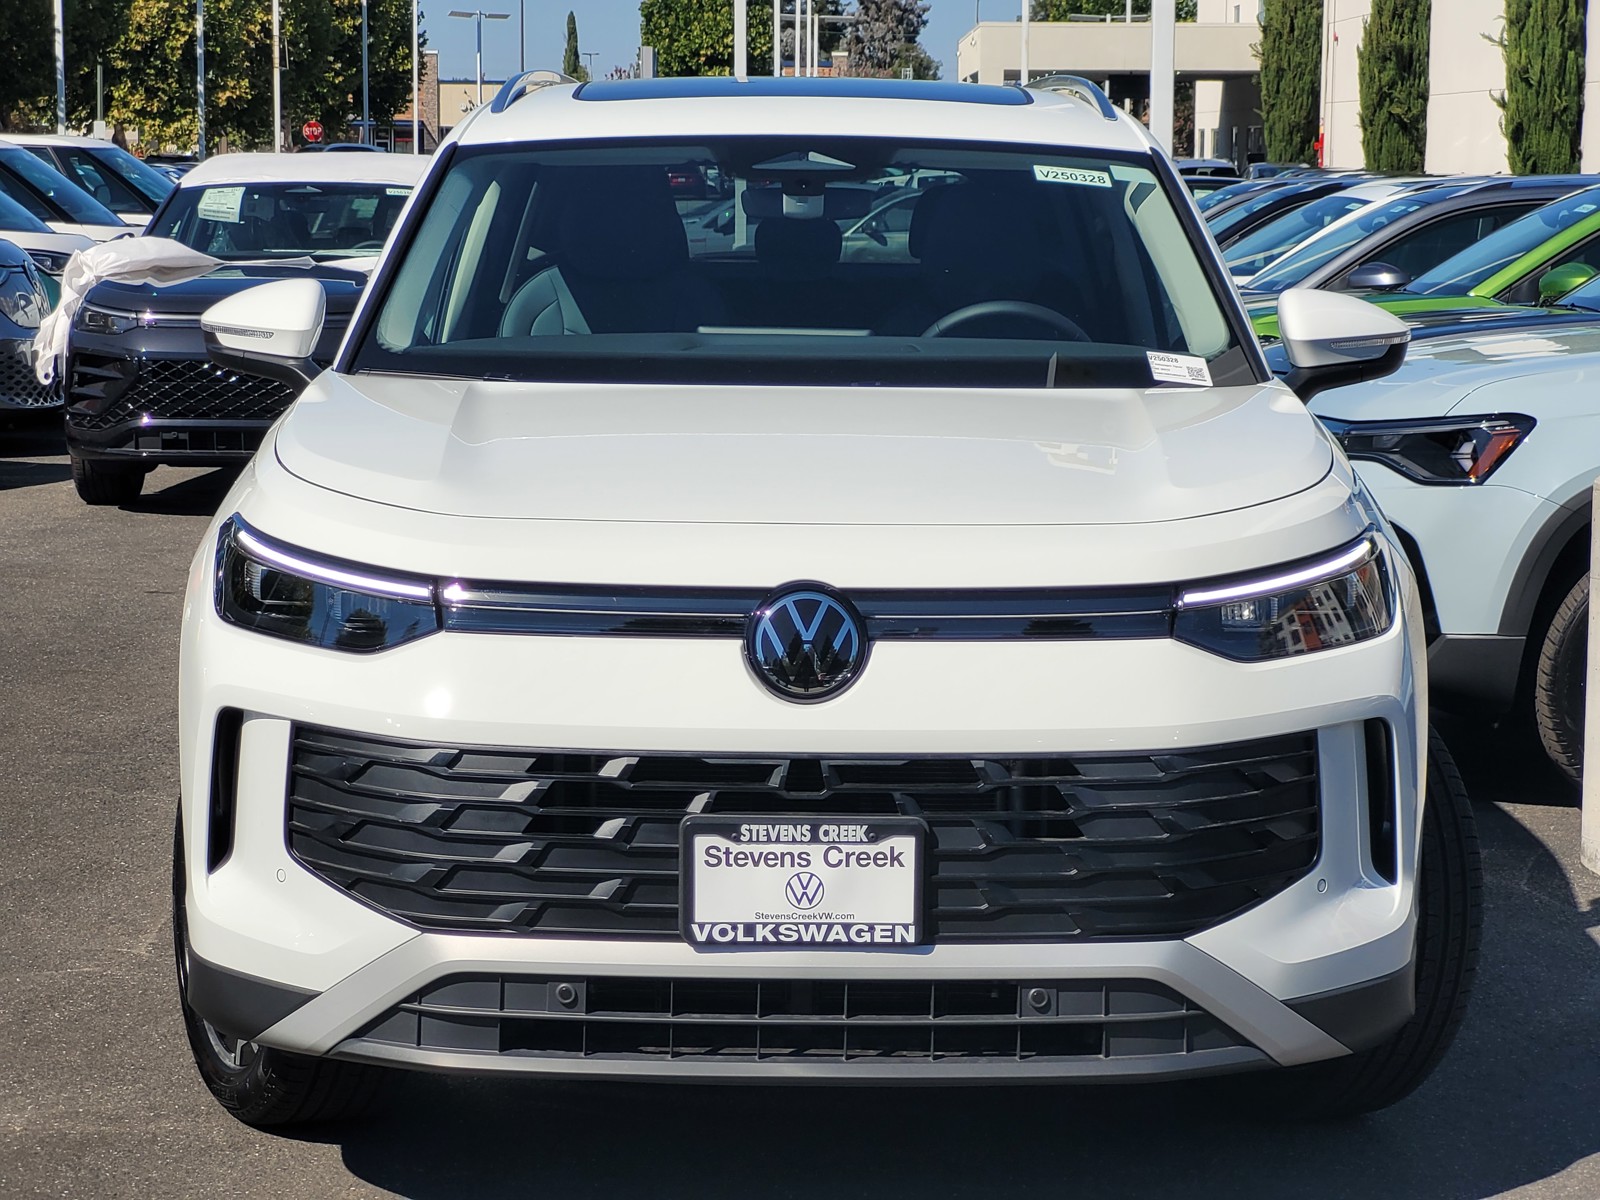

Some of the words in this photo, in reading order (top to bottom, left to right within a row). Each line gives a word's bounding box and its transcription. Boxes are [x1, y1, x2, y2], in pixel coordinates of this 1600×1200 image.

[304, 127, 322, 136] STOP
[1039, 169, 1106, 184] V250328
[739, 823, 811, 842] STEVENS
[818, 824, 869, 842] CREEK
[703, 845, 812, 868] Stevens
[822, 845, 906, 868] Creek
[754, 911, 856, 921] StevensCreekVW.com
[691, 923, 916, 943] VOLKSWAGEN
